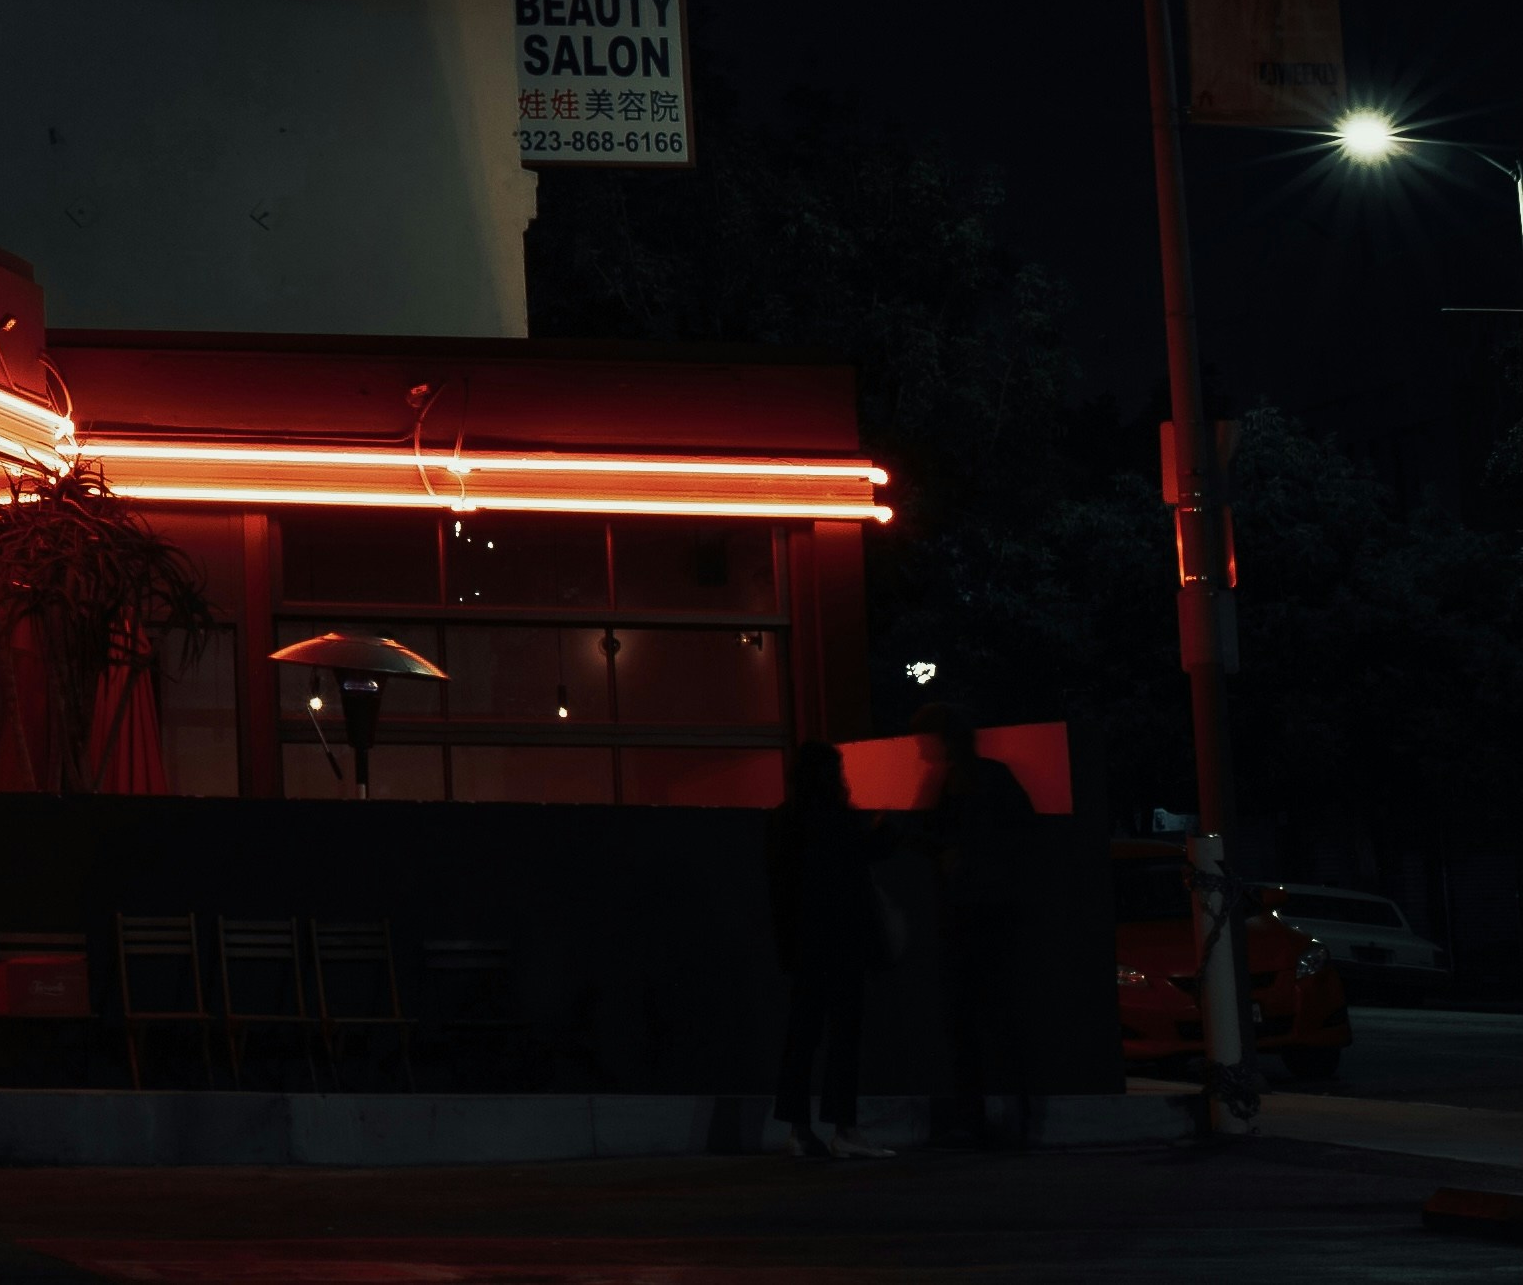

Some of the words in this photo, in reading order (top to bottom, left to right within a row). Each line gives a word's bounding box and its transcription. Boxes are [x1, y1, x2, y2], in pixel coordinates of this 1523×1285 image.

[523, 34, 670, 77] SALON
[518, 88, 680, 122] 娃娃美容院
[519, 130, 683, 152] 323-868-6166
